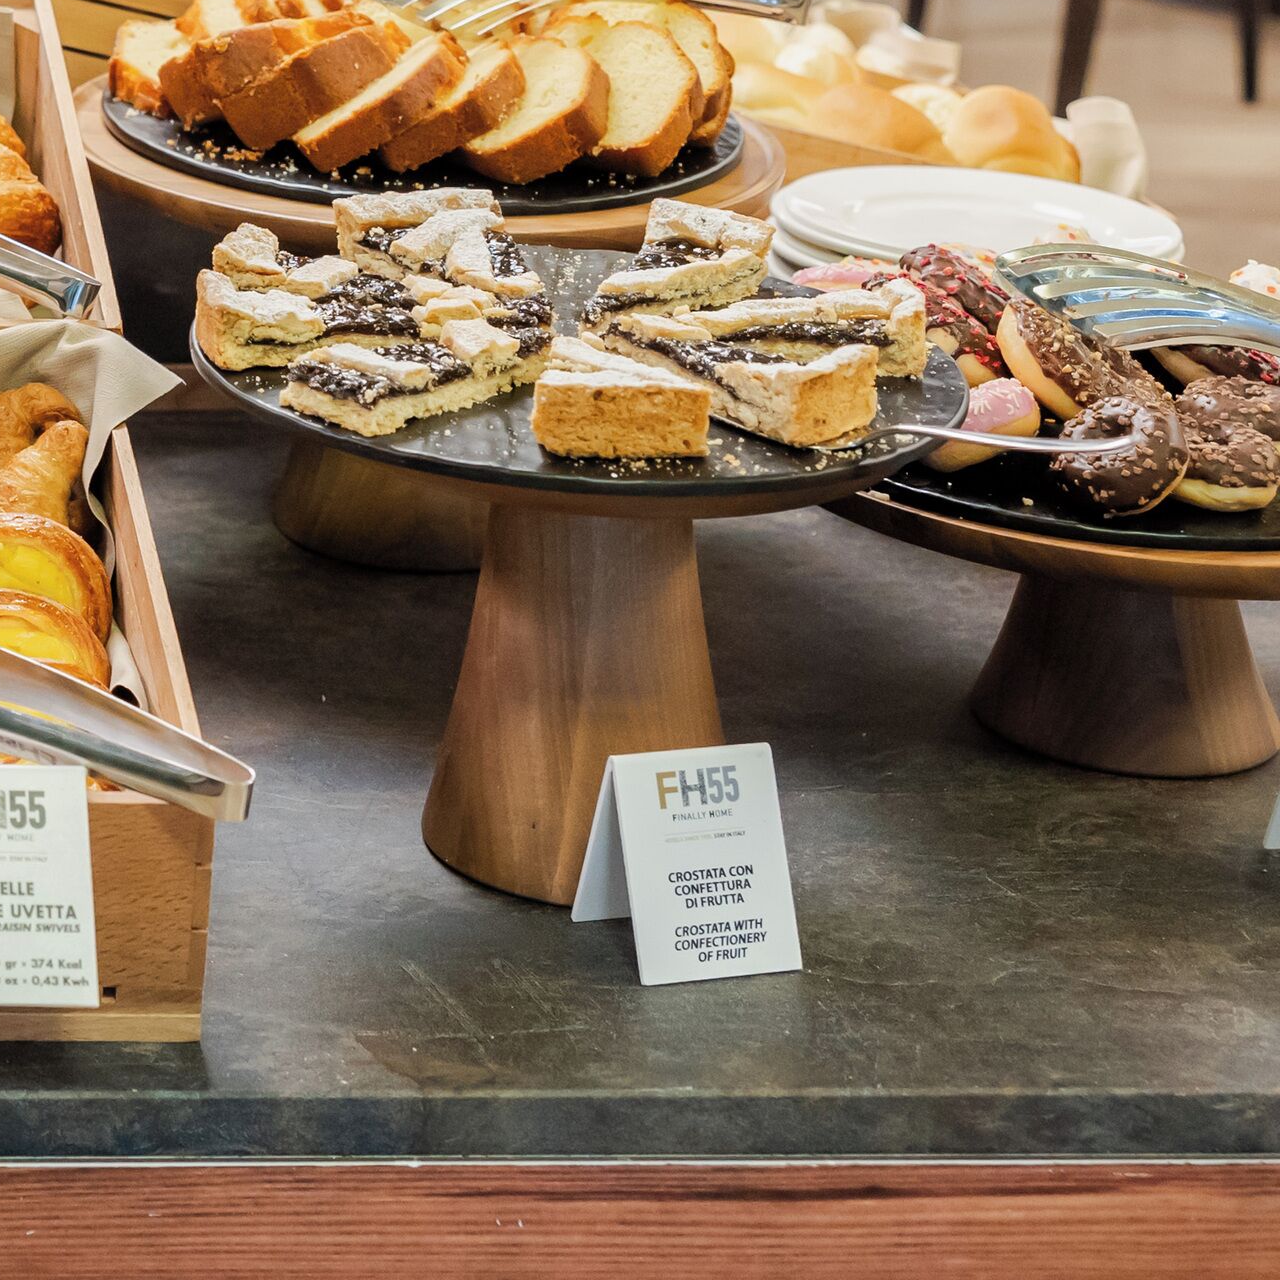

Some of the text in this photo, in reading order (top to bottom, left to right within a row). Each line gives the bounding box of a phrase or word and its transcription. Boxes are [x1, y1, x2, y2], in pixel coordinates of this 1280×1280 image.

[655, 765, 740, 810] FH55
[672, 808, 734, 822] FINALLY HOME
[668, 864, 754, 883] CROSTATA CON
[674, 878, 752, 896] CONFETTURA
[685, 893, 745, 909] DI FRUTTA
[11, 904, 77, 919] UVETTA
[35, 922, 81, 933] SWIVELS
[675, 918, 763, 938] CROSTATA WITH
[674, 931, 767, 951] CONFECTIONERY
[698, 947, 748, 962] OF FRUIT
[5, 960, 17, 970] gr
[31, 959, 53, 969] 374
[58, 958, 83, 969] Kcal
[62, 976, 90, 987] Kwh
